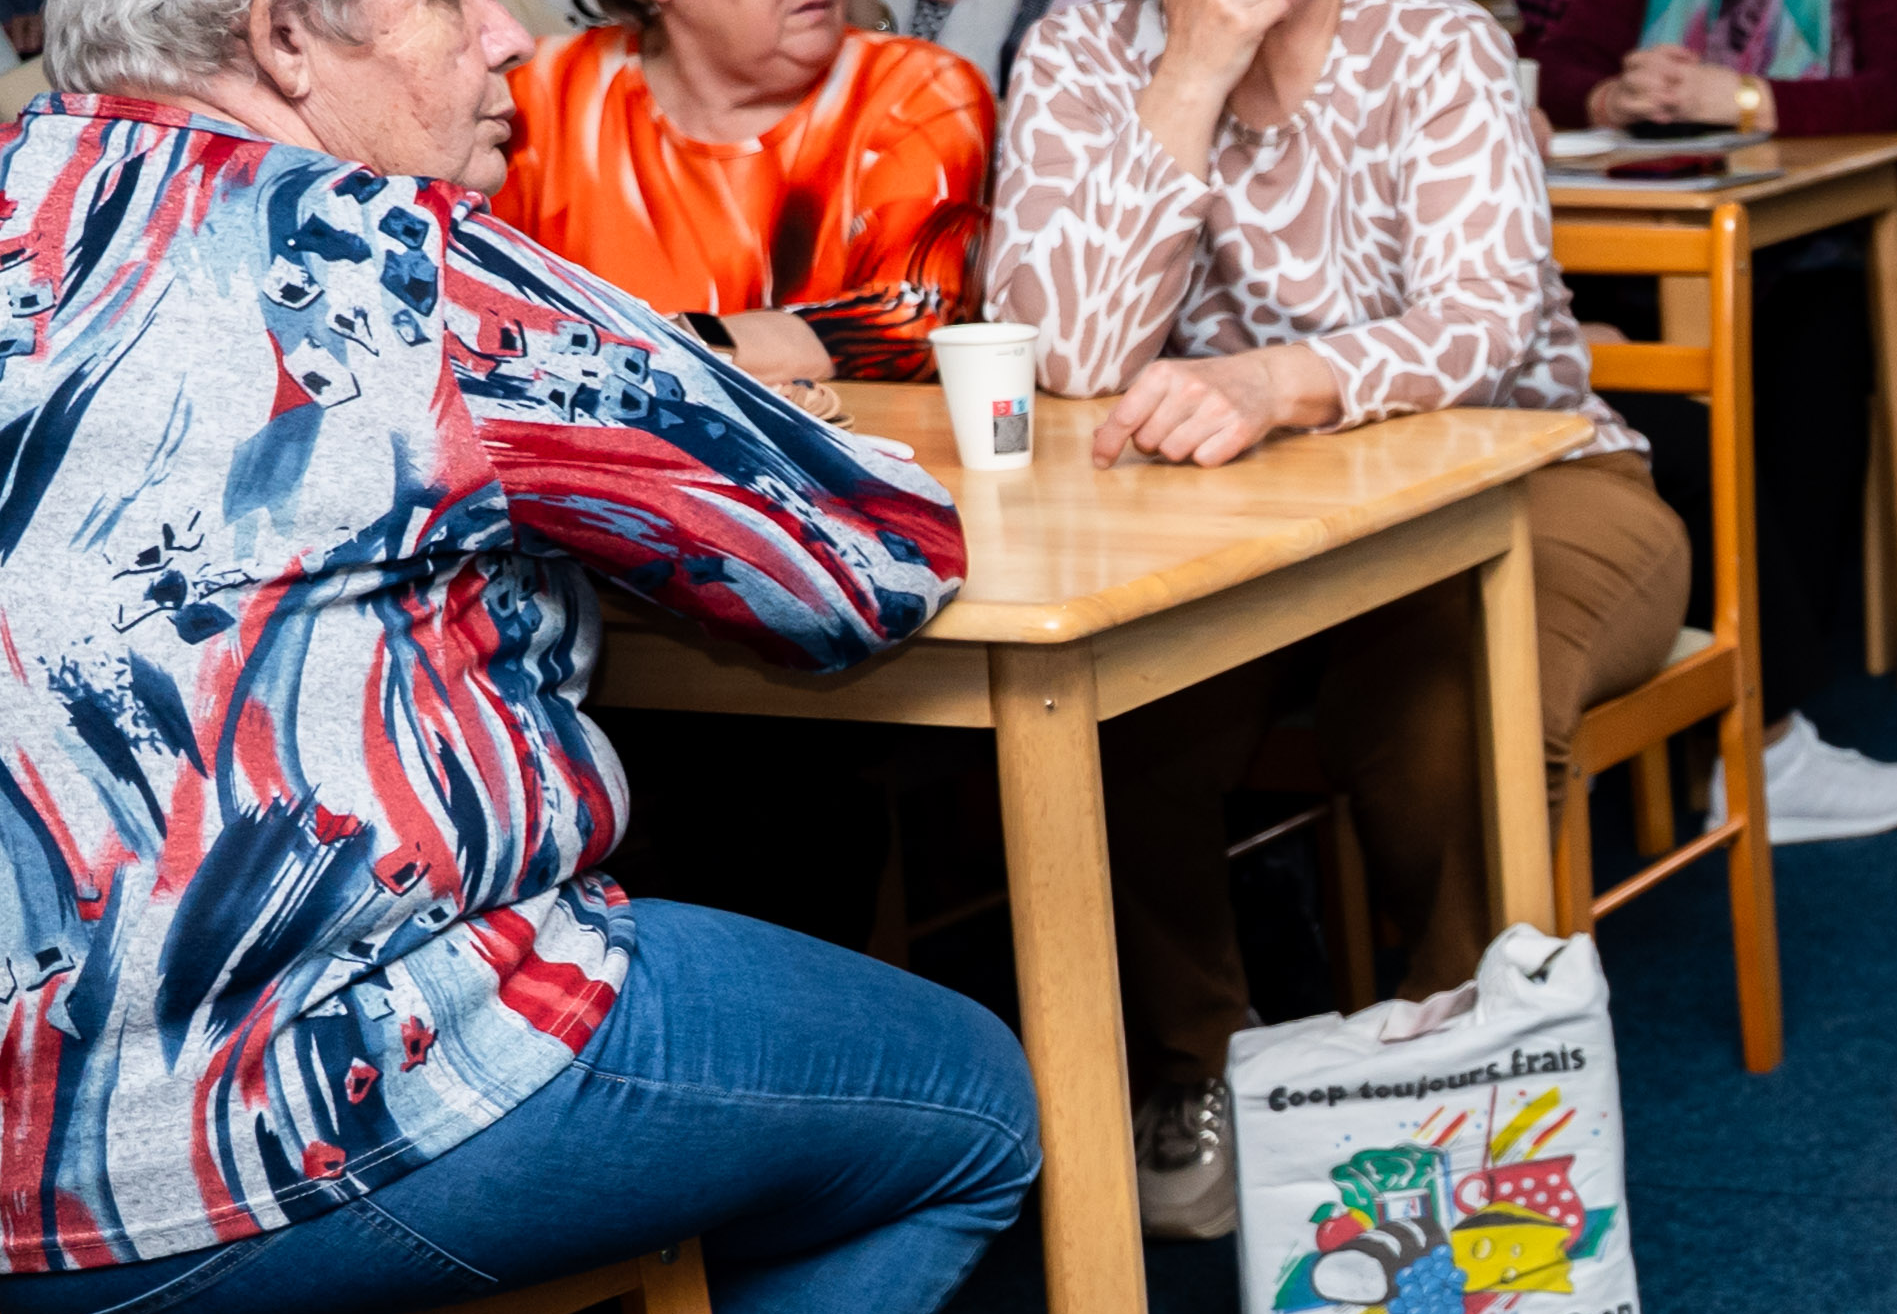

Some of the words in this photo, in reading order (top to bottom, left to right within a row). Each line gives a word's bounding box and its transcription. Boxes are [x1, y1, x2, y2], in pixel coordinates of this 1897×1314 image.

[1267, 1085, 1348, 1112] Coop
[1358, 1061, 1501, 1100] toujours
[1510, 1043, 1587, 1077] frais
